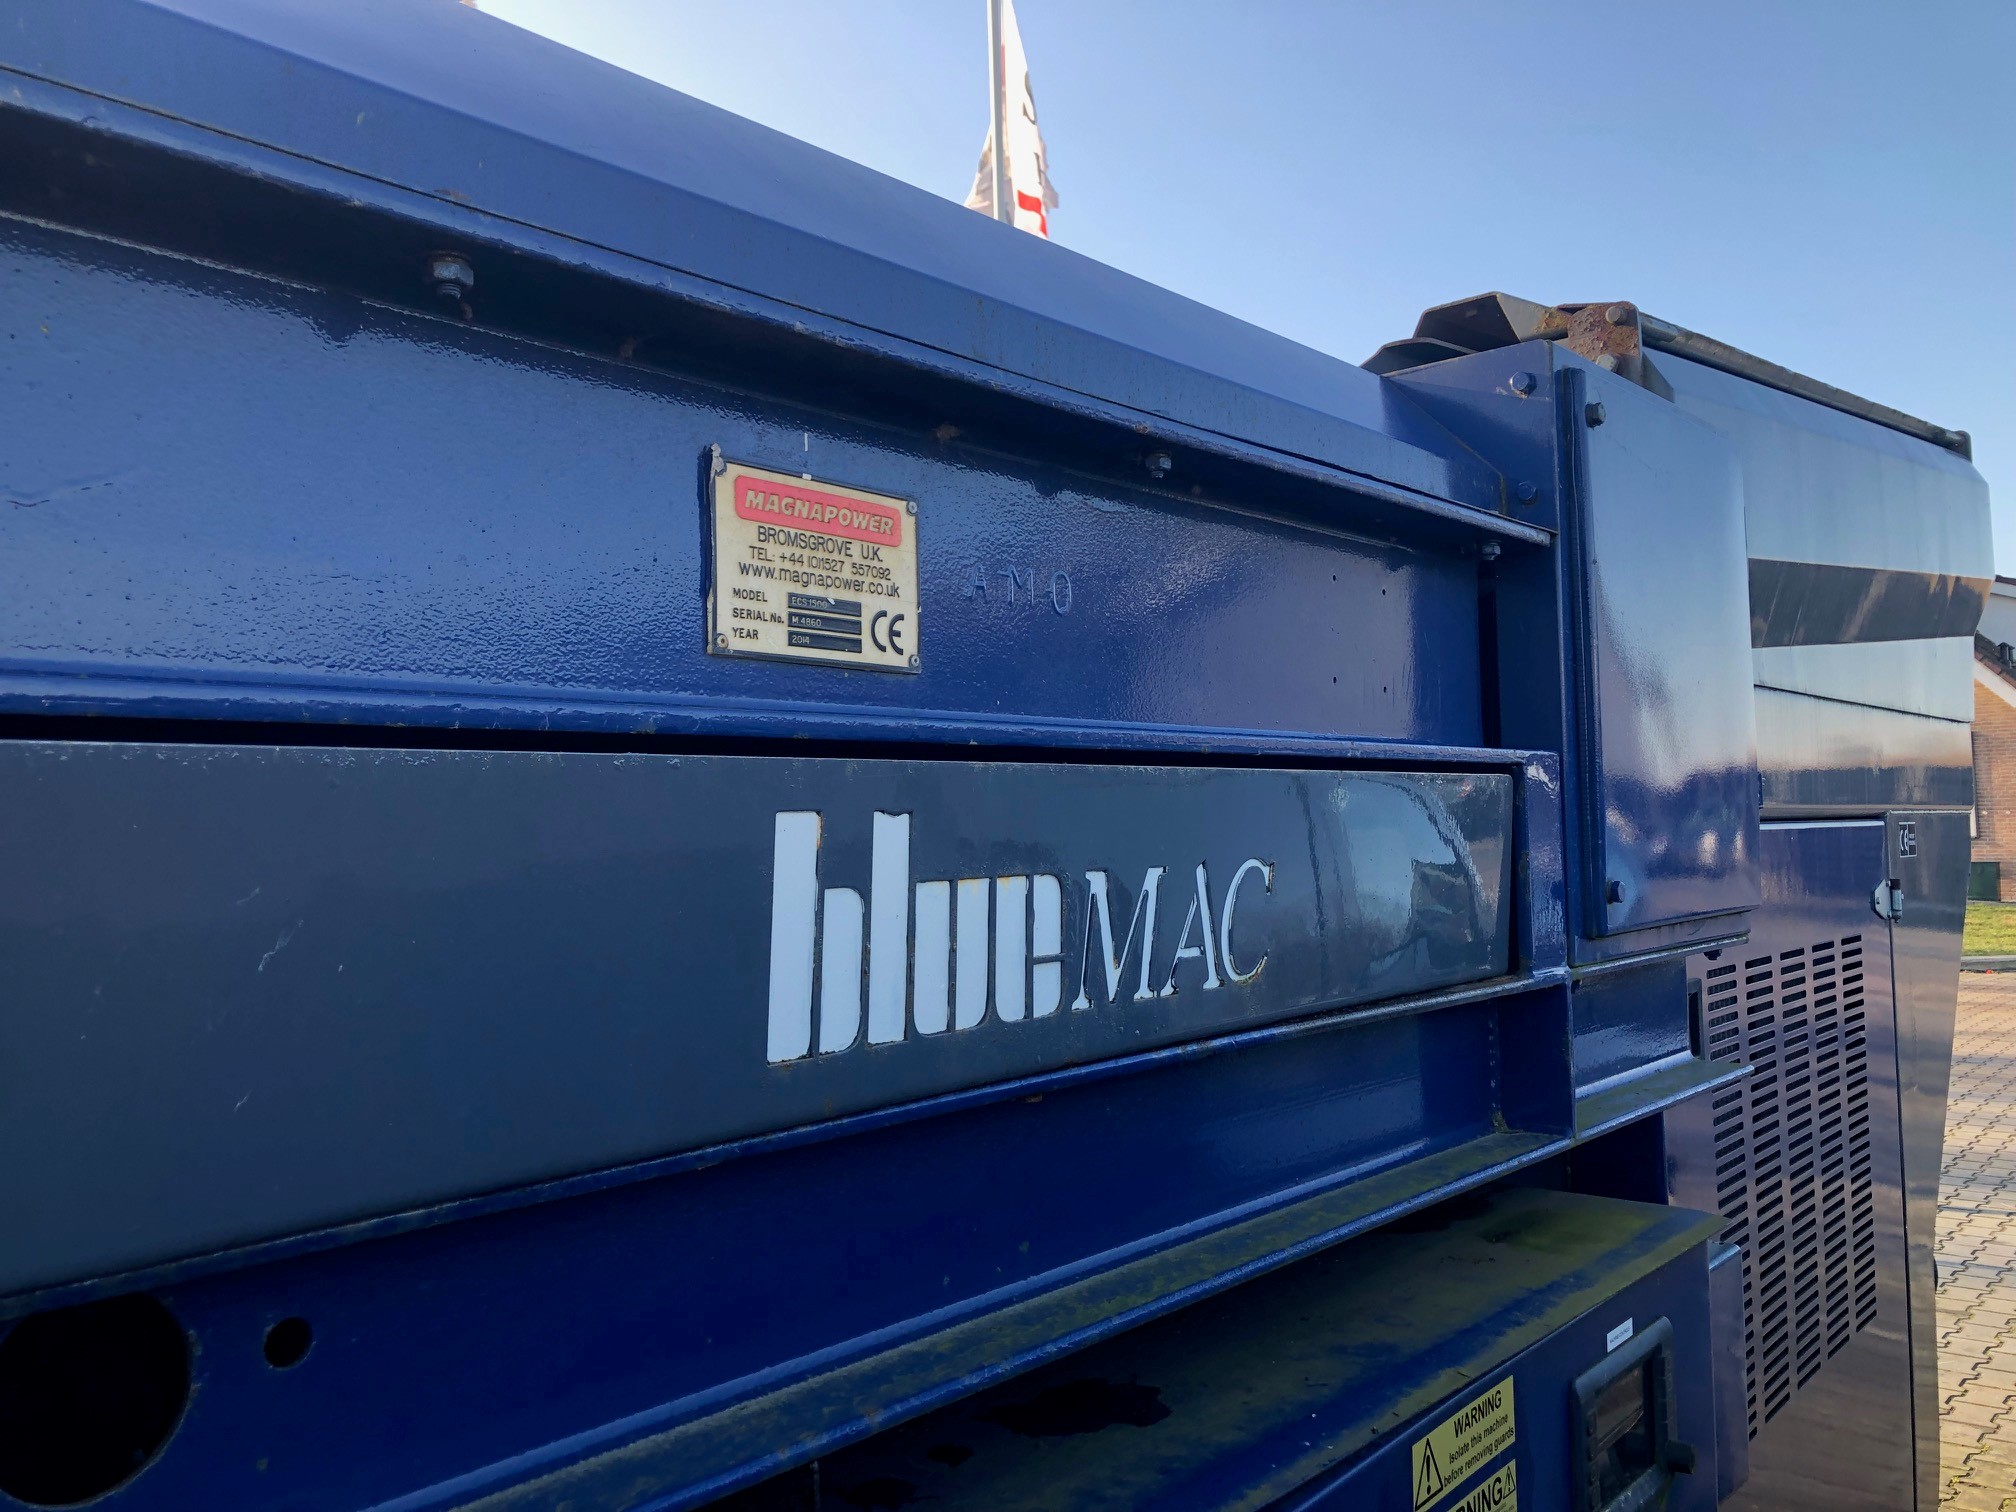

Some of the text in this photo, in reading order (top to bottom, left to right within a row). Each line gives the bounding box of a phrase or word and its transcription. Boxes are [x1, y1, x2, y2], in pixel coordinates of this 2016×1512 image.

[744, 488, 894, 536] MAGNAPOWER
[757, 525, 883, 563] BROMSGROVE U.K.
[738, 562, 900, 598] www.magnapower.co.uk
[749, 545, 776, 563] TEL:
[779, 552, 804, 567] +44
[851, 564, 891, 581] 557092
[732, 587, 768, 603] MODEL
[732, 607, 768, 623] SERIAL
[770, 612, 784, 624] No.
[871, 609, 904, 655] CE
[732, 626, 810, 645] YEAR 2014
[1454, 1389, 1502, 1438] WARNING
[1471, 1432, 1482, 1449] this
[1483, 1414, 1508, 1438] machine
[1444, 1426, 1514, 1487] before removing guards
